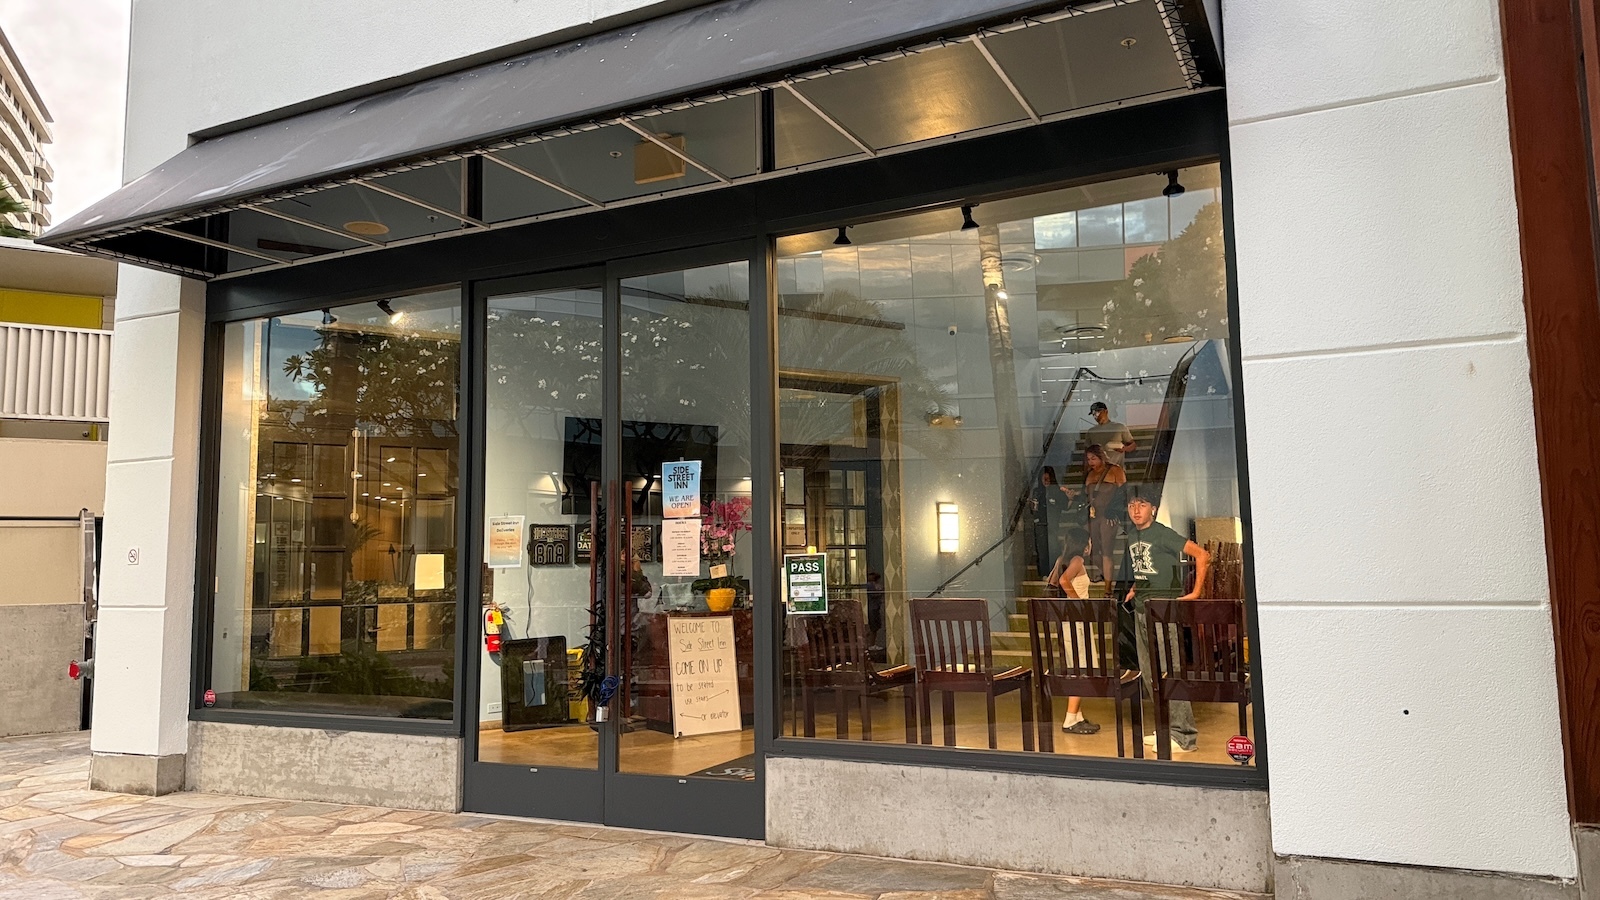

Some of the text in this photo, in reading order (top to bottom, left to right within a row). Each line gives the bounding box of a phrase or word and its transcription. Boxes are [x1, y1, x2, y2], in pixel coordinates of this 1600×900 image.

[672, 466, 690, 475] SIDE
[668, 473, 694, 482] STREET
[791, 562, 819, 572] PASS
[674, 620, 720, 634] WELCOME TO
[698, 638, 714, 650] Street
[676, 659, 722, 675] COME ON UP
[687, 683, 693, 691] be
